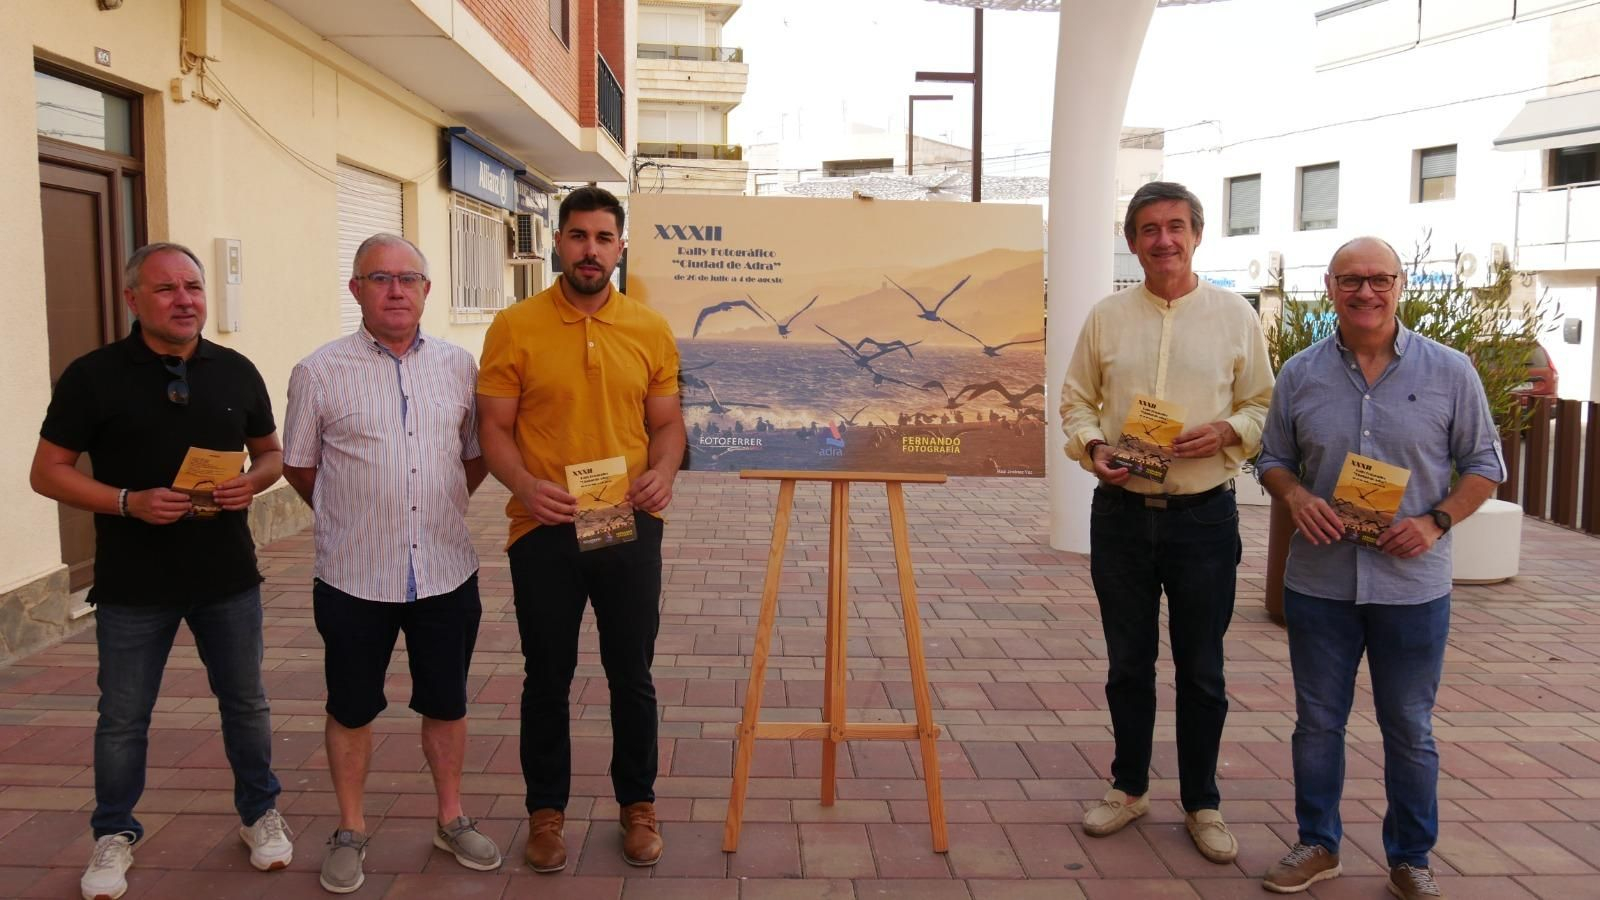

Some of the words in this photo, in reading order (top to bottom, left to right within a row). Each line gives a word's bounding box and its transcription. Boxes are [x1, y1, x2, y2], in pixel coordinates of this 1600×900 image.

[478, 160, 500, 196] Allianz
[654, 224, 722, 241] XXXII
[677, 247, 708, 257] Rally
[710, 247, 776, 258] Fotográfico
[726, 260, 741, 270] de
[700, 436, 763, 447] FOTOFERRER
[902, 436, 961, 446] FERNANDO
[902, 445, 961, 454] FOTOGRAFÍA
